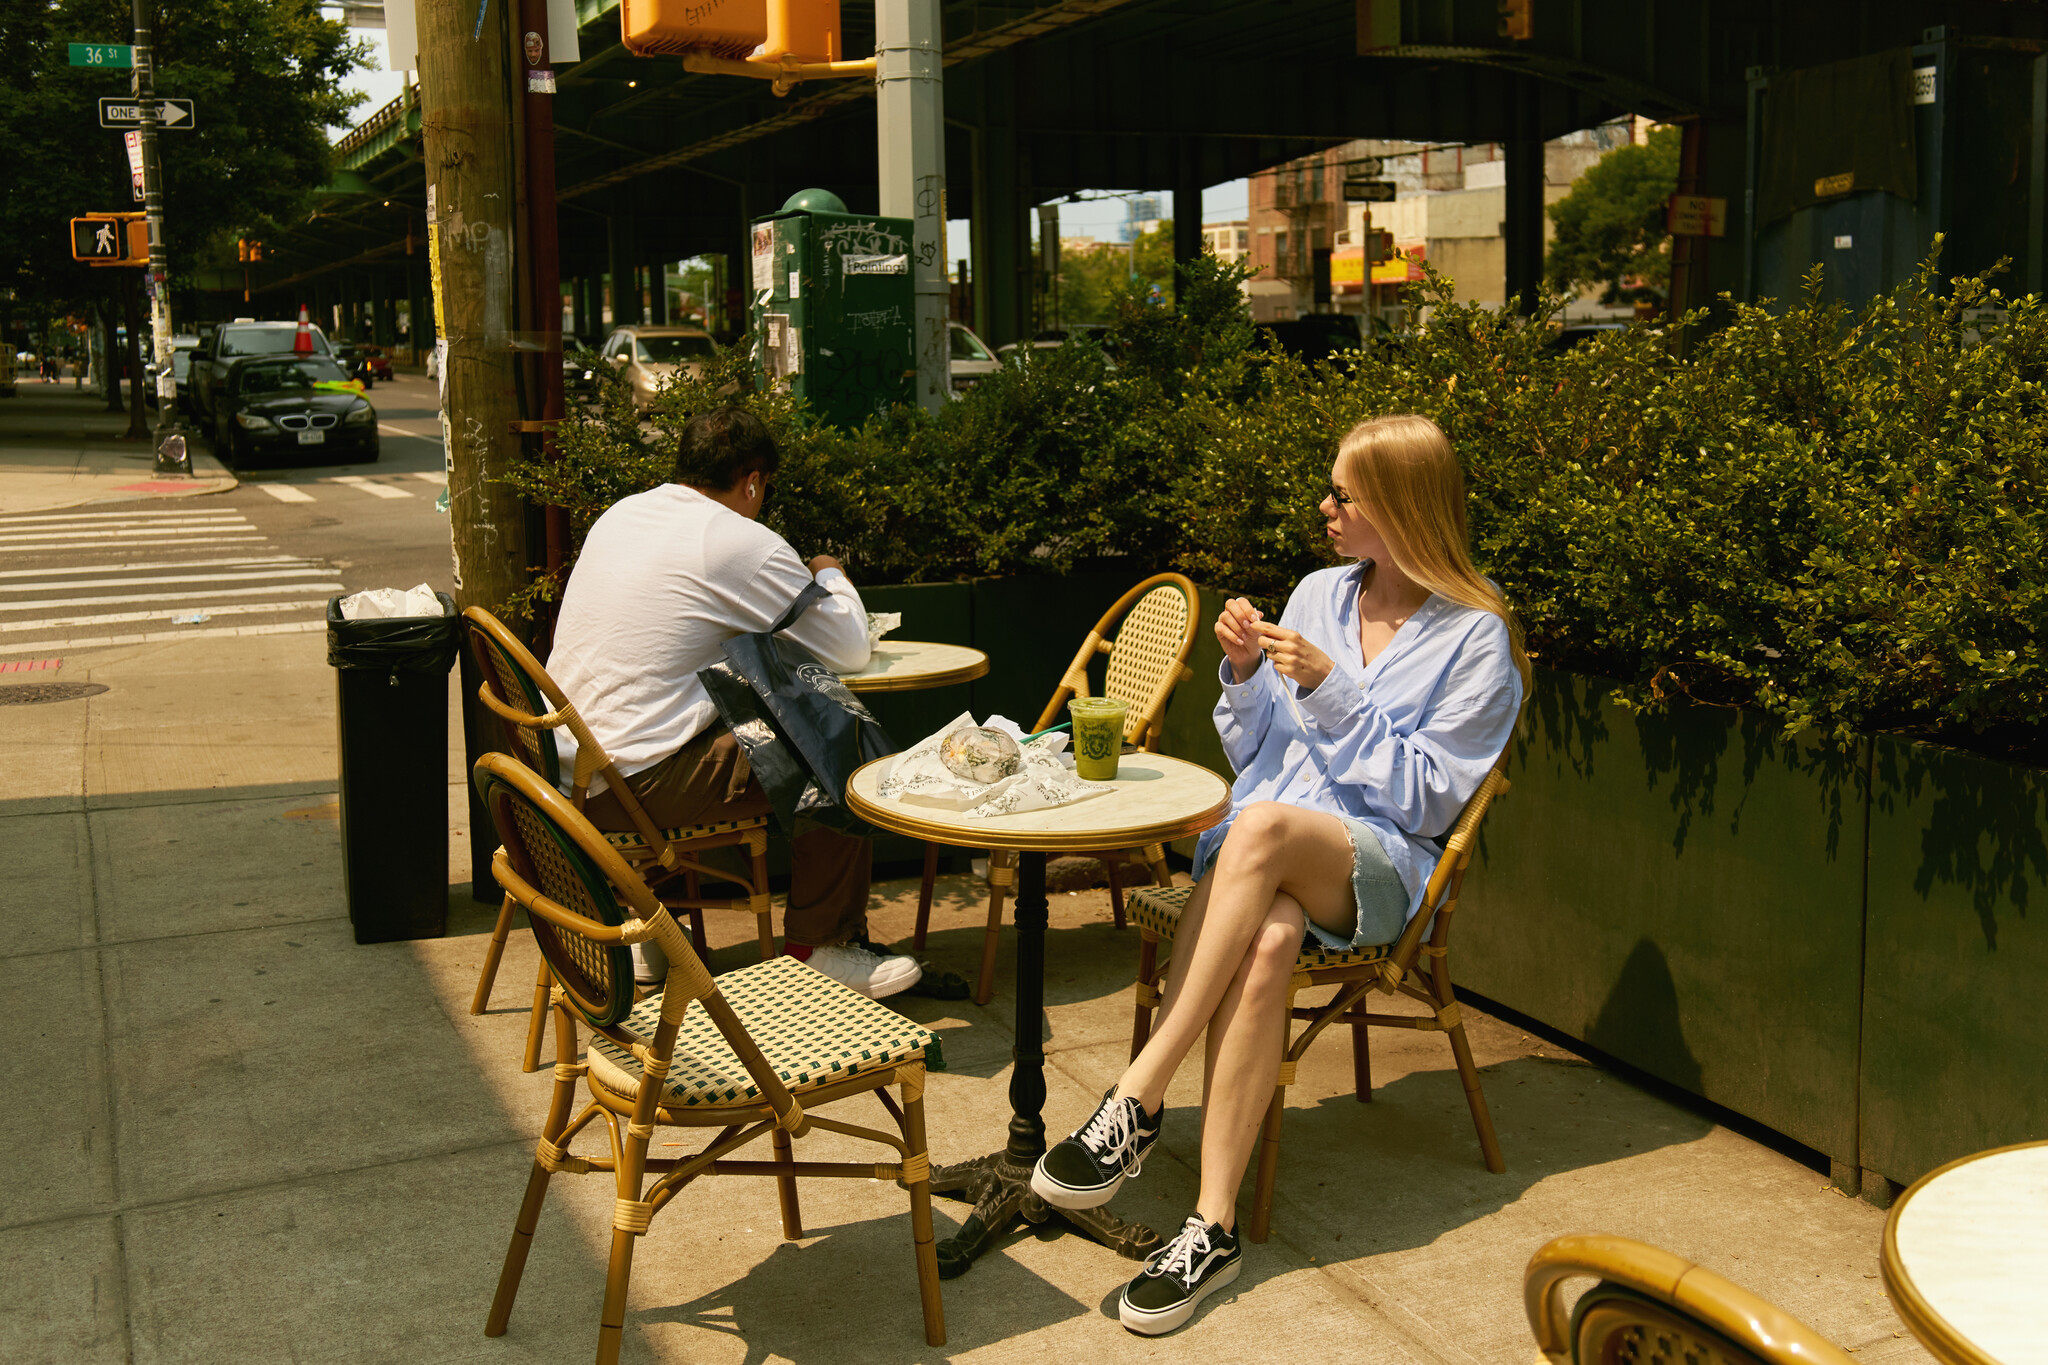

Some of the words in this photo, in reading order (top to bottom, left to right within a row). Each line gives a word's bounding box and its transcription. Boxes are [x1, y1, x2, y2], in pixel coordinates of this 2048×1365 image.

[85, 46, 103, 64] 36
[108, 47, 118, 59] St
[110, 107, 136, 118] ONE
[1689, 200, 1706, 211] NO
